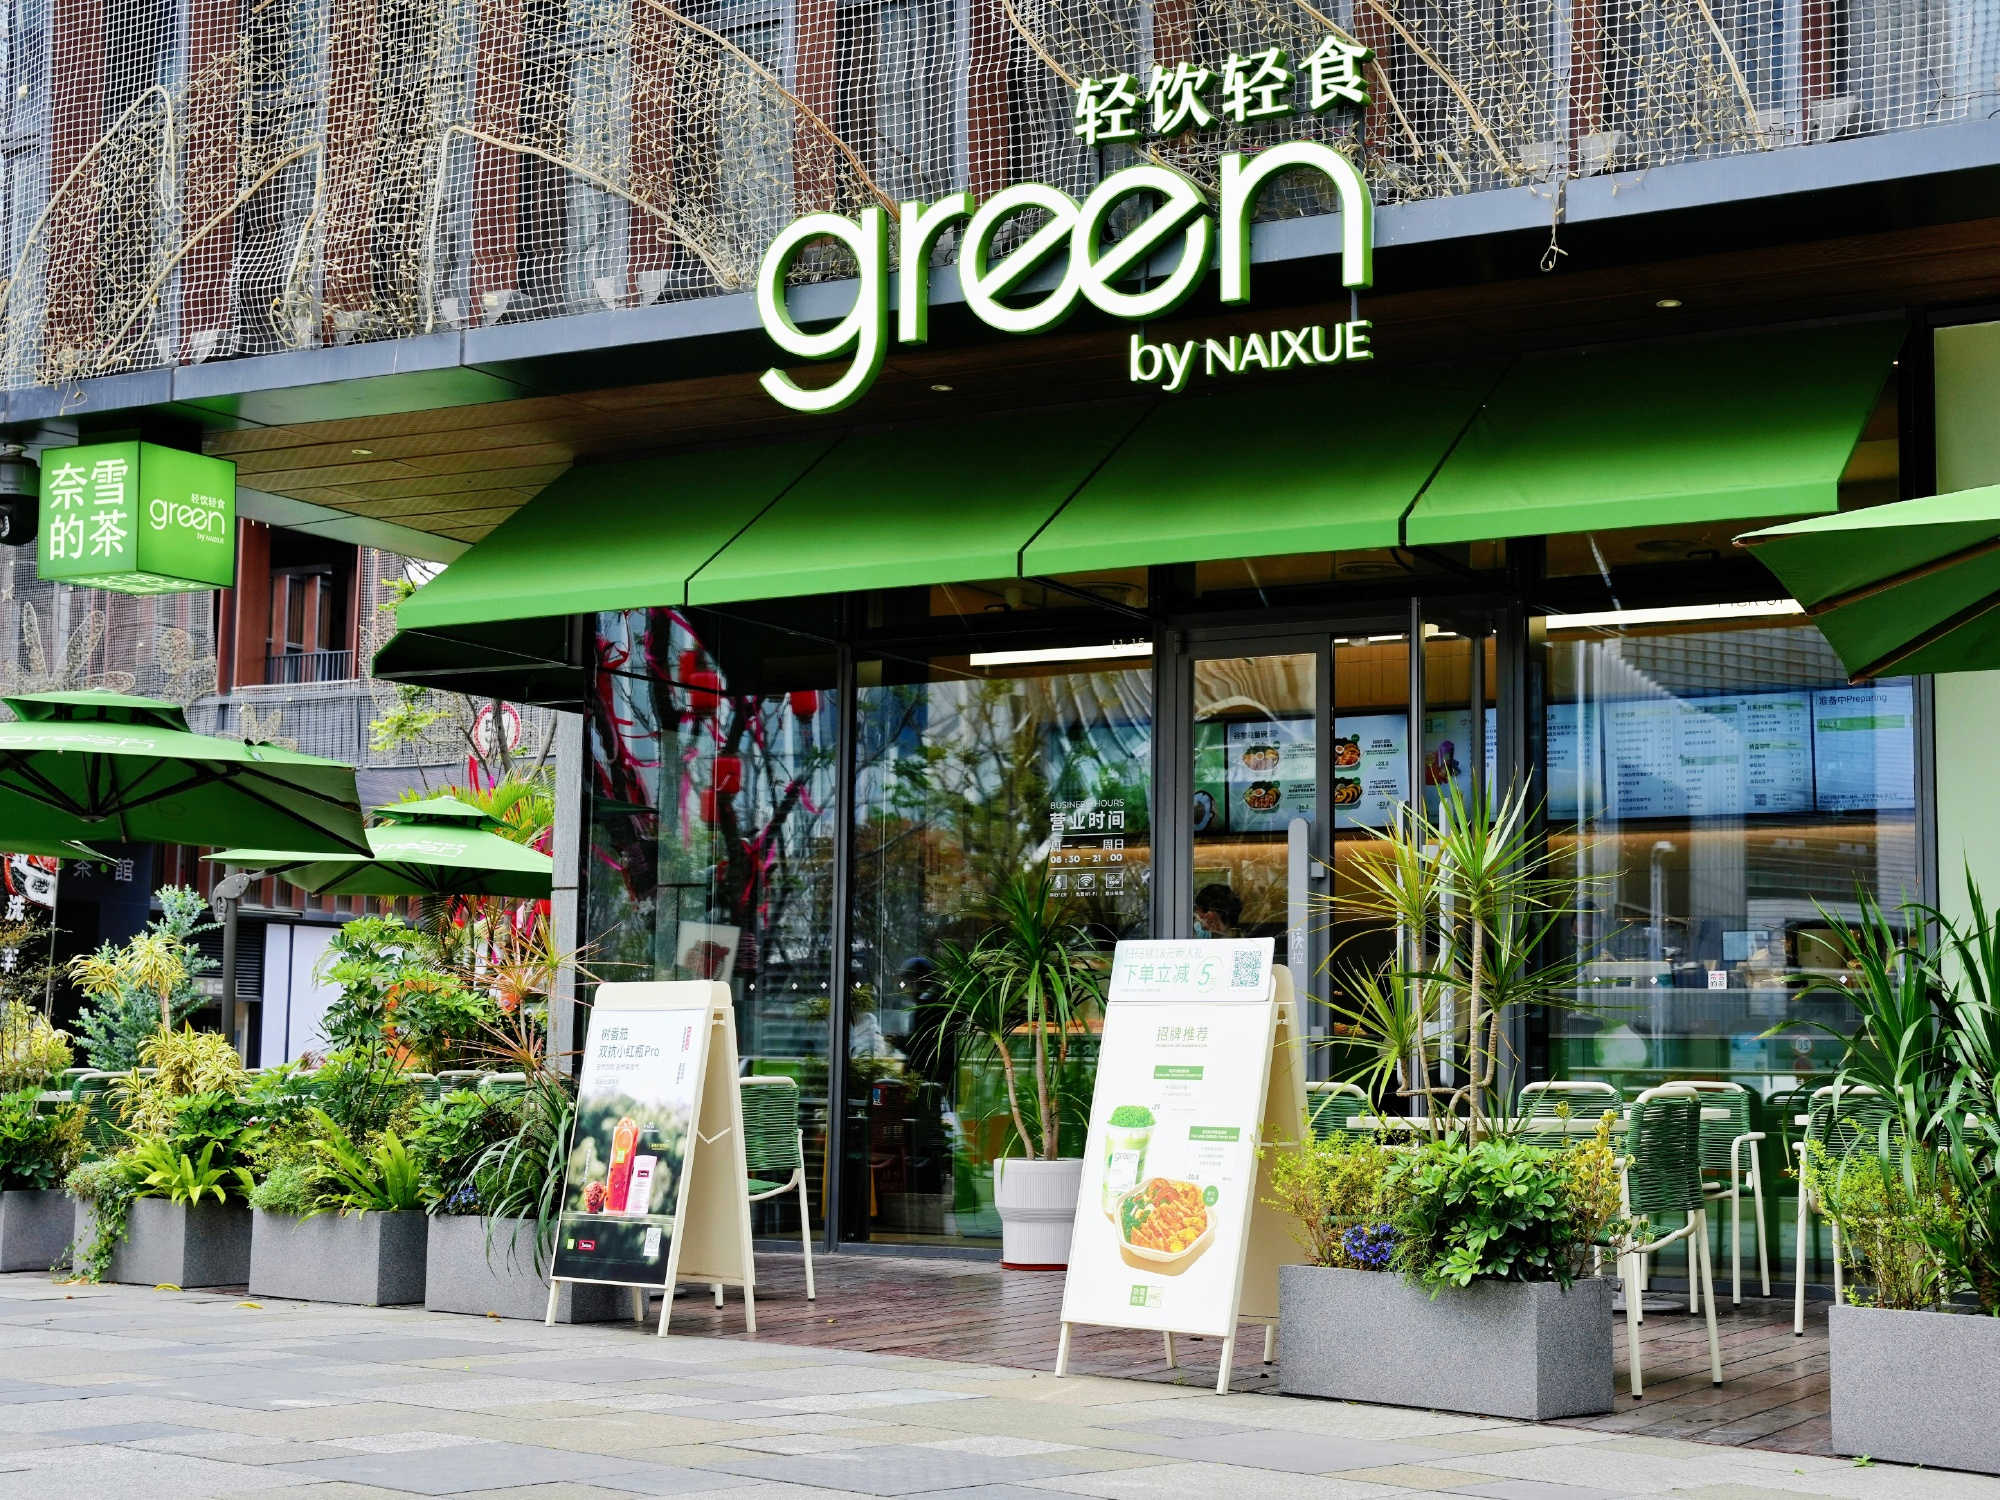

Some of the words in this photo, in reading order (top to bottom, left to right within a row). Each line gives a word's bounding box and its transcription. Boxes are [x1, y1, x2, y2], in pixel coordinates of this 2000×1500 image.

[1073, 35, 1374, 146] 轻饮轻食
[757, 139, 1373, 414] green
[1130, 334, 1199, 392] by
[1205, 319, 1374, 377] NAIXUE
[49, 458, 129, 510] 奈雪
[190, 492, 226, 510] 轻饮轻食
[149, 498, 226, 535] green
[49, 509, 129, 561] 的茶
[196, 531, 206, 542] by
[1050, 801, 1095, 809] BUSINE
[1096, 798, 1125, 808] HOURS
[1050, 810, 1125, 831] 营业时间
[1103, 838, 1124, 851] 周日
[1292, 950, 1304, 964] 拉
[1123, 963, 1190, 984] 下单立减
[601, 1027, 629, 1041] 树番茄
[1156, 1026, 1209, 1042] 招牌推荐
[598, 1044, 660, 1059] 双抗小红瓶Pro
[1114, 1152, 1138, 1162] green
